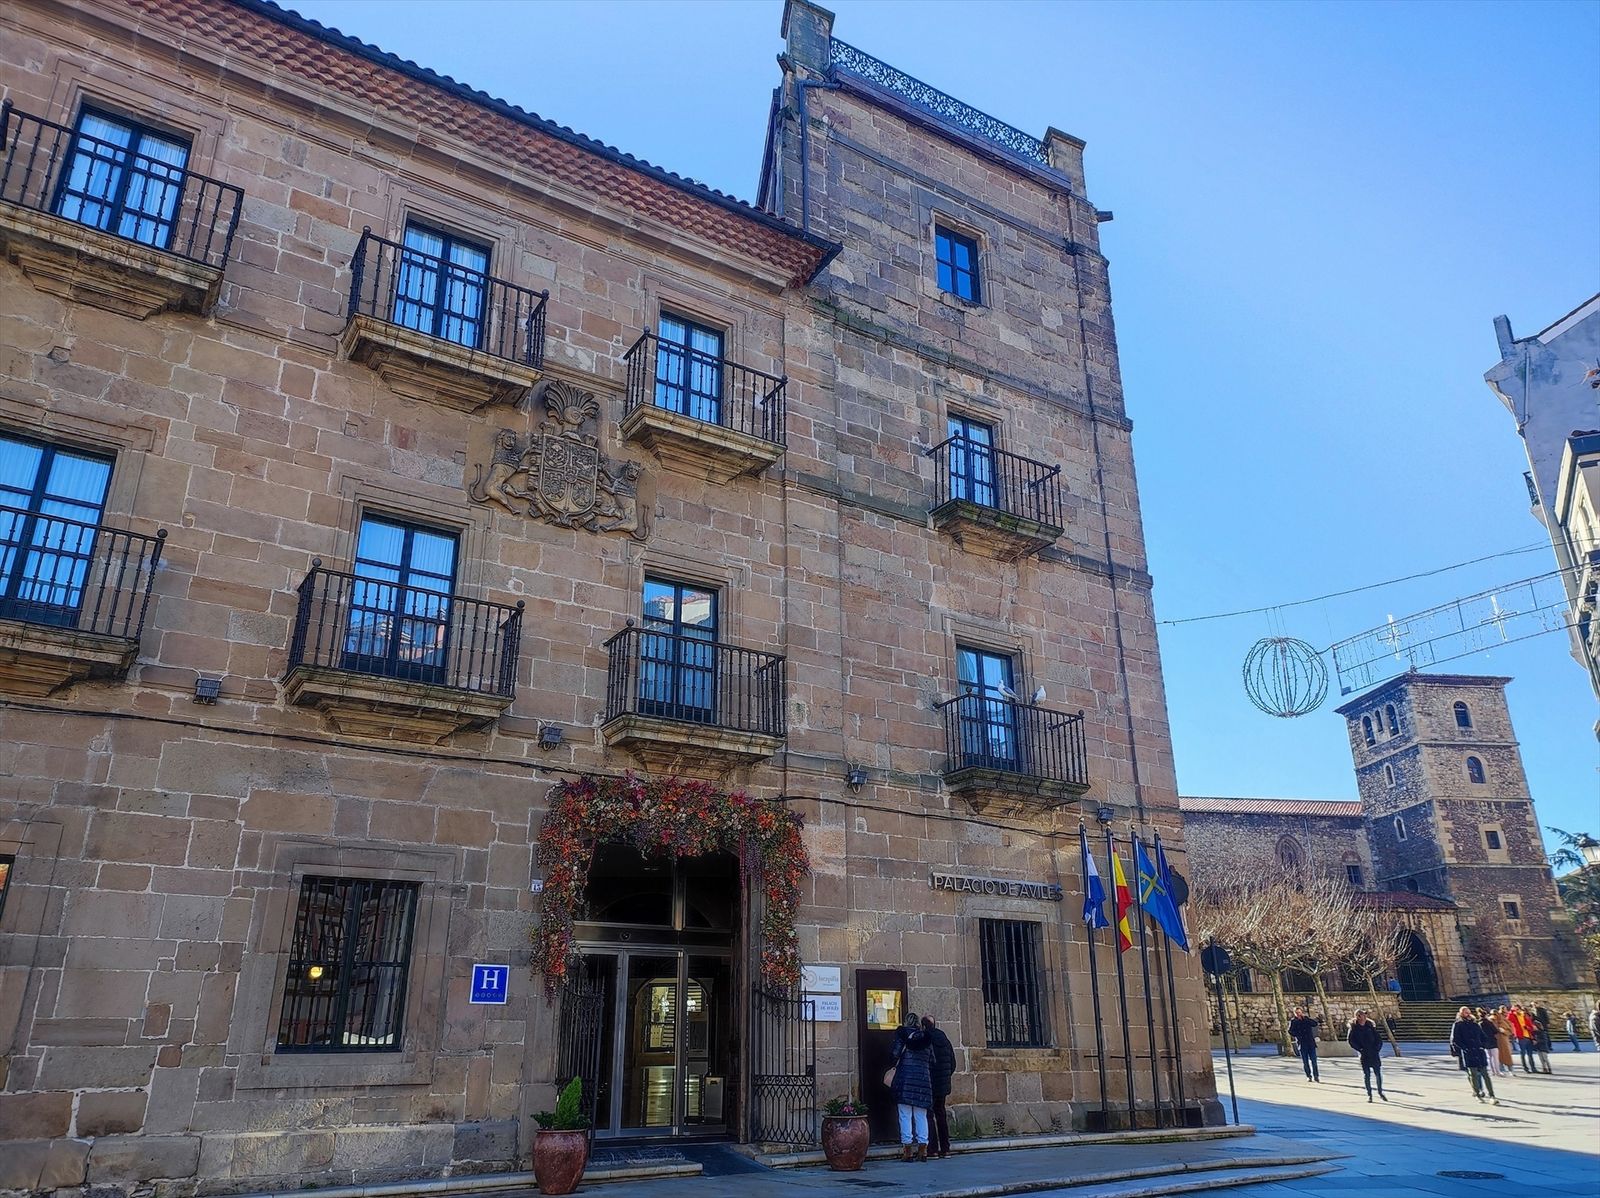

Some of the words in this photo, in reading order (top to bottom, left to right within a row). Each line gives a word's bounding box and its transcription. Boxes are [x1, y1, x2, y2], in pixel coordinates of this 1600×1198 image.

[934, 875, 995, 894] PALACIO
[999, 880, 1017, 896] DE
[480, 969, 500, 990] H
